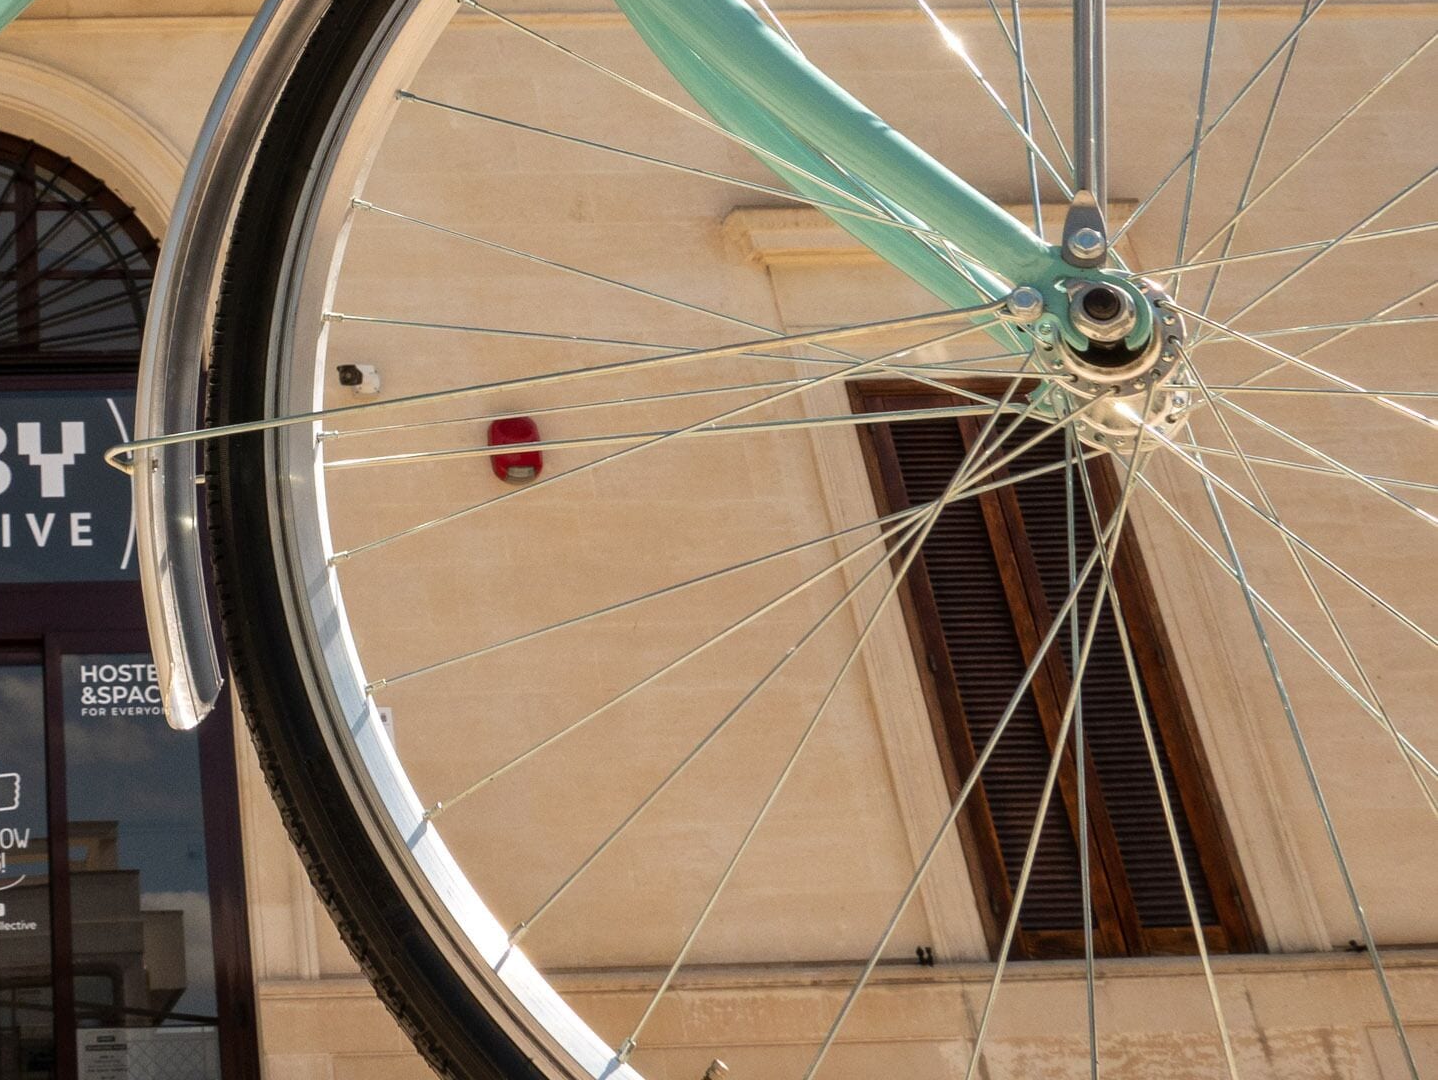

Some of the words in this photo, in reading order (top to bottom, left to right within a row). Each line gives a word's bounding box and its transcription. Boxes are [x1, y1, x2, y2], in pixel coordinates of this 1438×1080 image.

[80, 663, 159, 683] HOSTE
[80, 685, 161, 705] &SPAC
[81, 707, 107, 717] FOR
[110, 706, 166, 716] EVERYO
